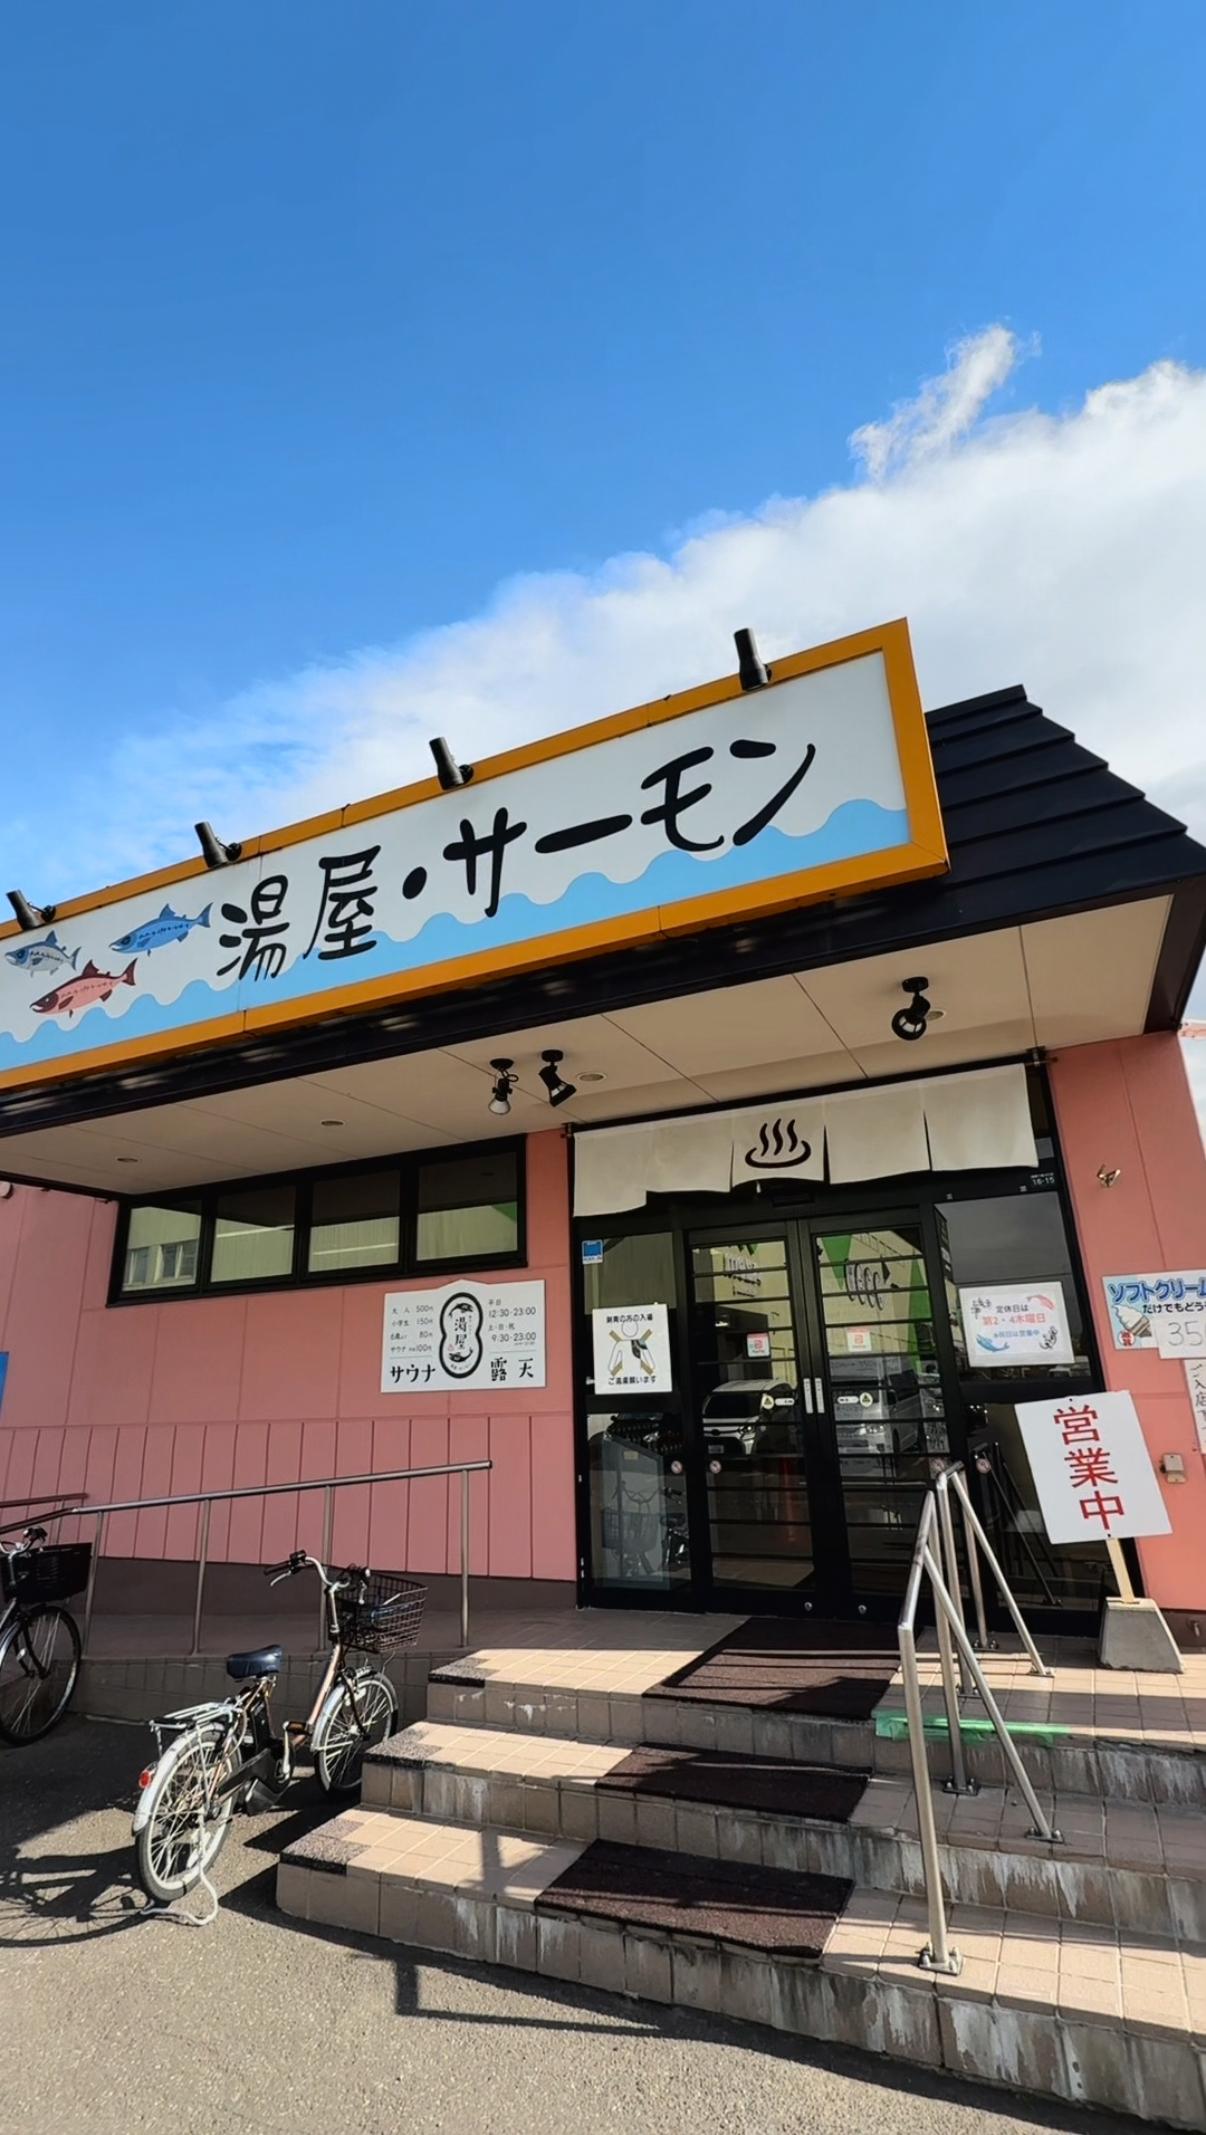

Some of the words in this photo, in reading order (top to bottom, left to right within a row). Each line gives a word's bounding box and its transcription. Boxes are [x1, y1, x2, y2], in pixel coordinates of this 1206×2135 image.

[216, 739, 816, 981] 湯屋・サーモン
[1143, 1301, 1206, 1314] だけでもどう
[1168, 1320, 1206, 1346] 35
[390, 1363, 436, 1384] サウナ
[490, 1356, 534, 1381] 露天
[1053, 1404, 1125, 1530] 営業中
